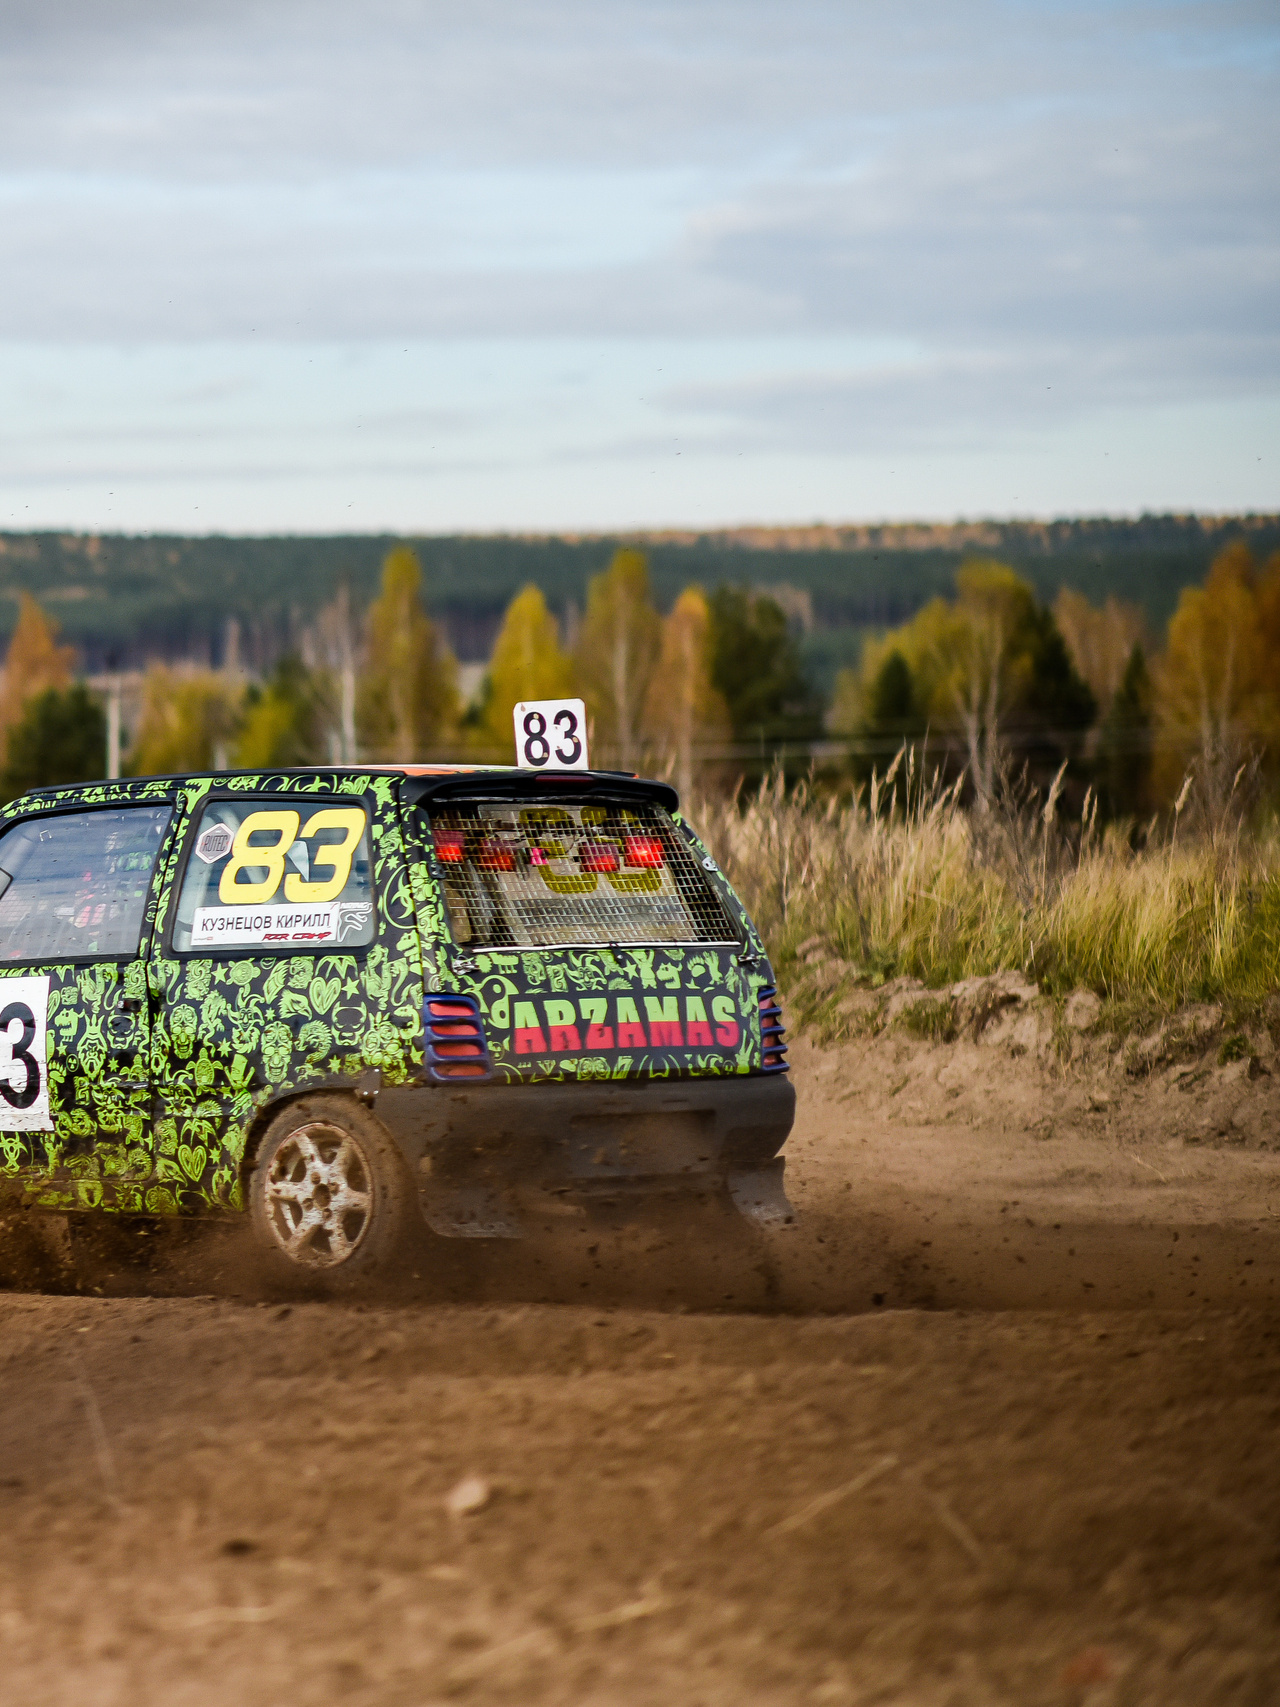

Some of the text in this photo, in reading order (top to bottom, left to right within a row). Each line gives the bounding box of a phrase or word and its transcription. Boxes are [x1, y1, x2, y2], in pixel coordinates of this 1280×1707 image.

[524, 709, 581, 766] 83
[218, 808, 367, 904] 83
[201, 913, 331, 932] КУЗНЕЦОВ КИРИЛЛ
[514, 997, 740, 1054] ARZAMAS
